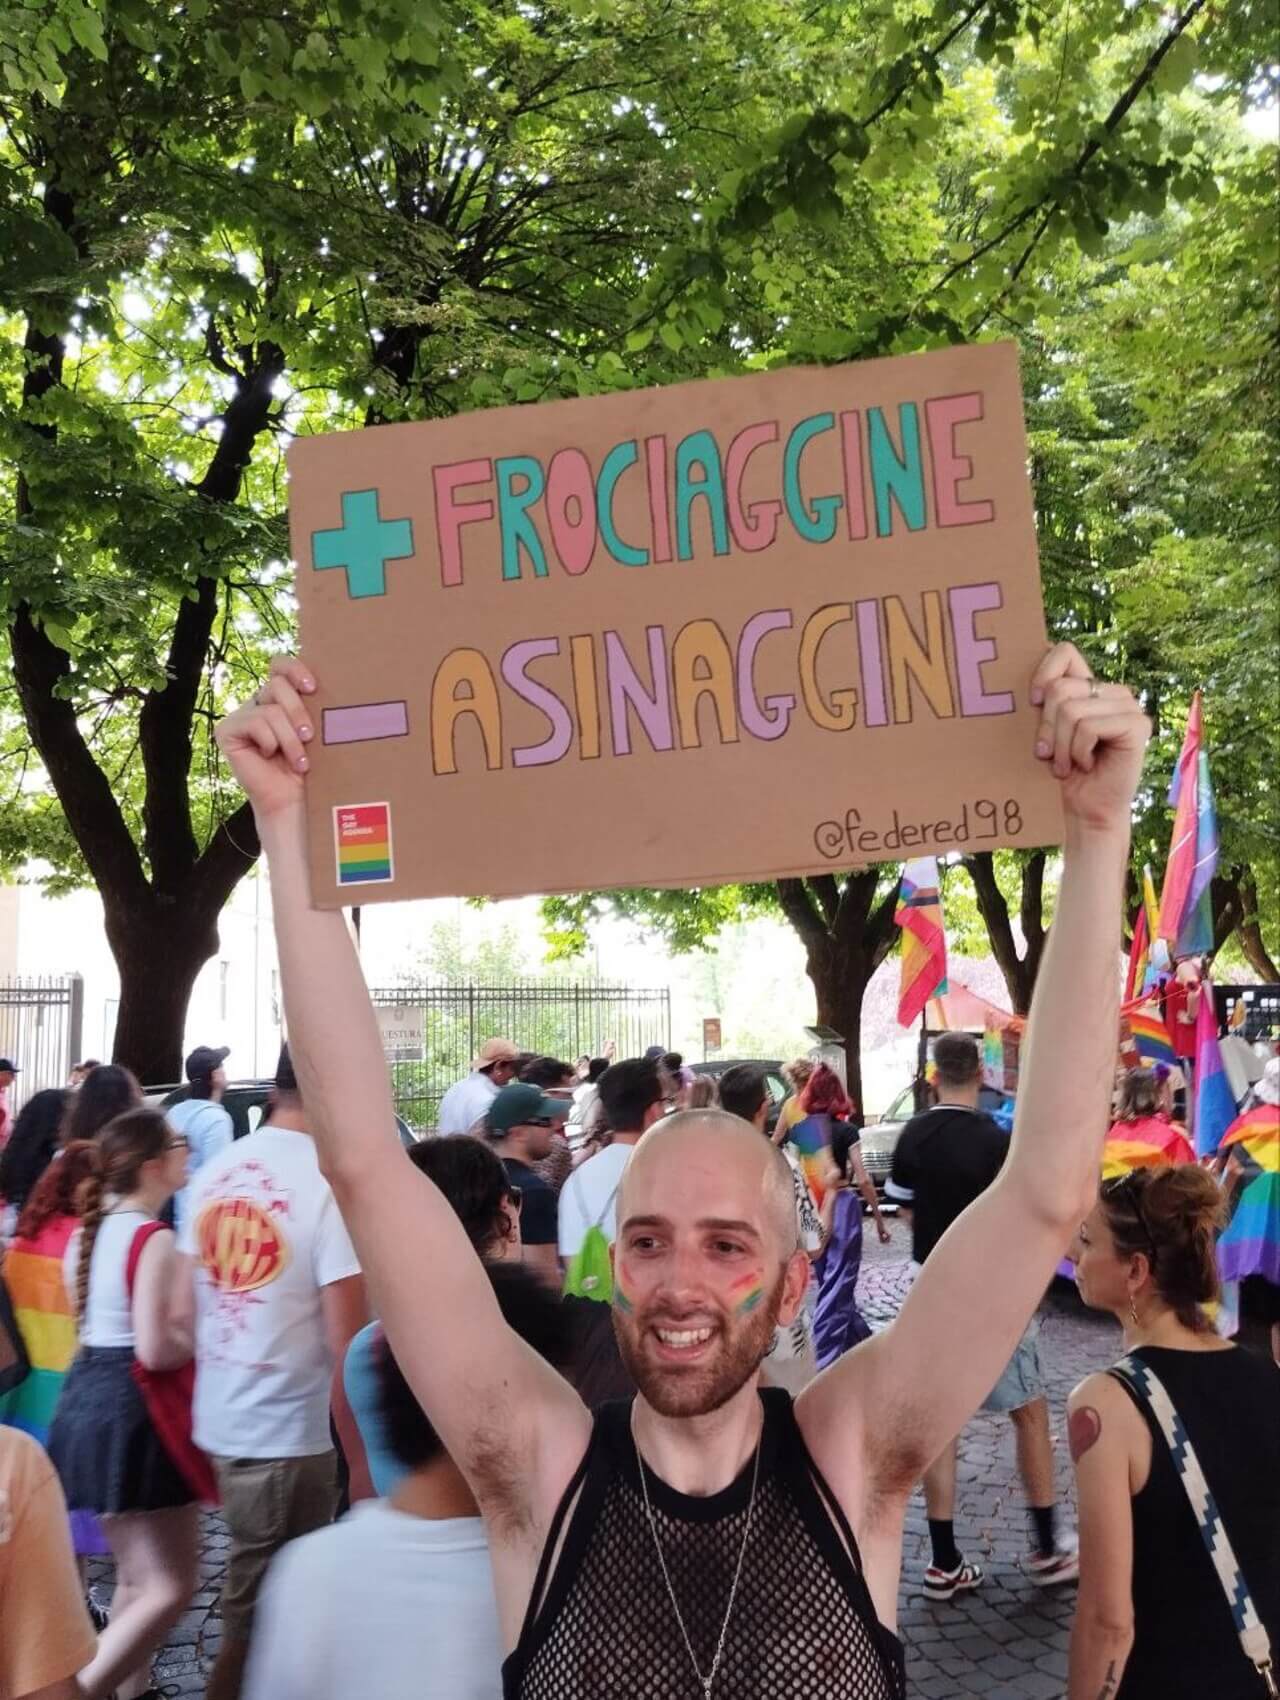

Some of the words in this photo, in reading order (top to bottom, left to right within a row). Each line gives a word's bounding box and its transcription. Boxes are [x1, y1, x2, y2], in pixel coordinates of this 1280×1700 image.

[432, 391, 995, 587] FROCIAGGINE
[430, 582, 1016, 776] ASINAGGINE
[813, 798, 1024, 859] @federed98
[383, 1029, 422, 1040] UESTURA
